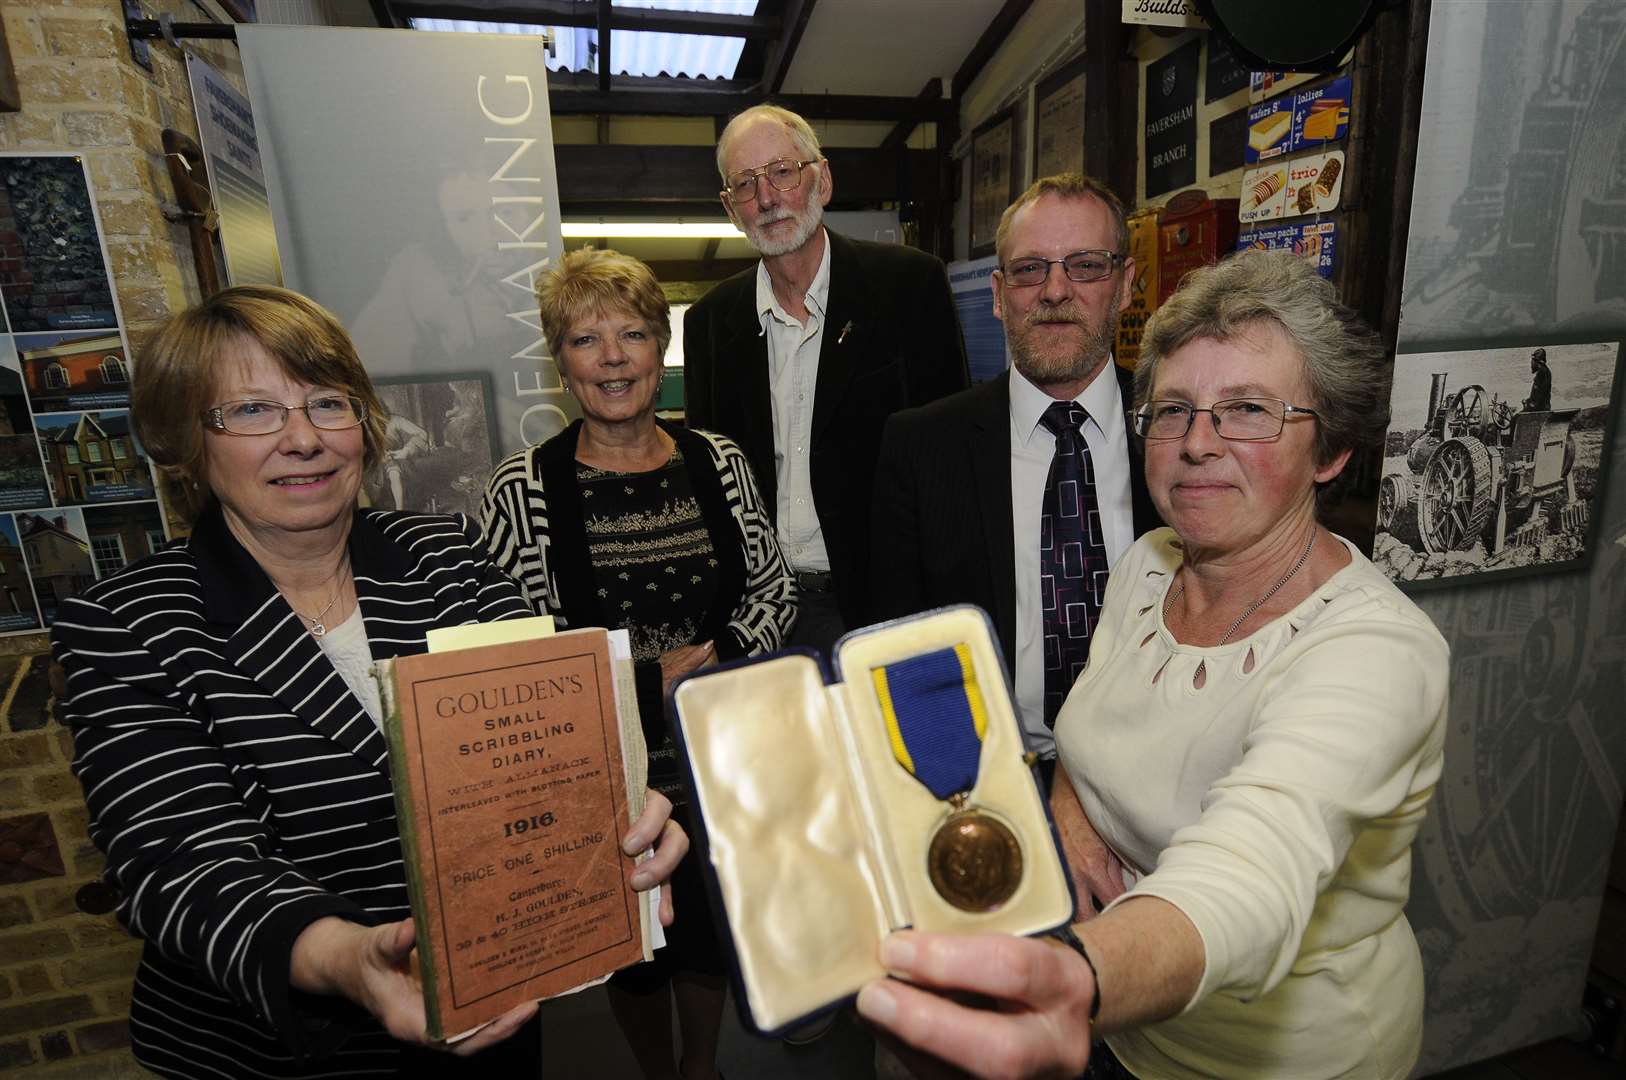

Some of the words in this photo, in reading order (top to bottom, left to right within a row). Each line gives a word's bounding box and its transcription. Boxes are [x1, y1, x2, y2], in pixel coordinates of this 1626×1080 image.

[1297, 88, 1324, 105] lollies
[1146, 104, 1194, 137] FAVERSHAM
[1152, 143, 1187, 169] BRANCH
[1291, 168, 1318, 180] trio
[1261, 209, 1271, 217] UP
[1277, 226, 1298, 240] packs
[435, 673, 584, 719] GOULDEN'S
[484, 709, 546, 731] SMALL
[459, 722, 576, 756] SCRIBBLING
[492, 747, 552, 769] DIARY,
[438, 795, 500, 817] INTERLEAVED
[505, 788, 528, 800] WITH
[531, 776, 573, 794] BLOTTING
[447, 778, 495, 797] WITH
[503, 811, 558, 838] 1916.
[453, 863, 497, 886] PRICE
[504, 853, 535, 870] ONE
[543, 831, 607, 860] SHILLING.
